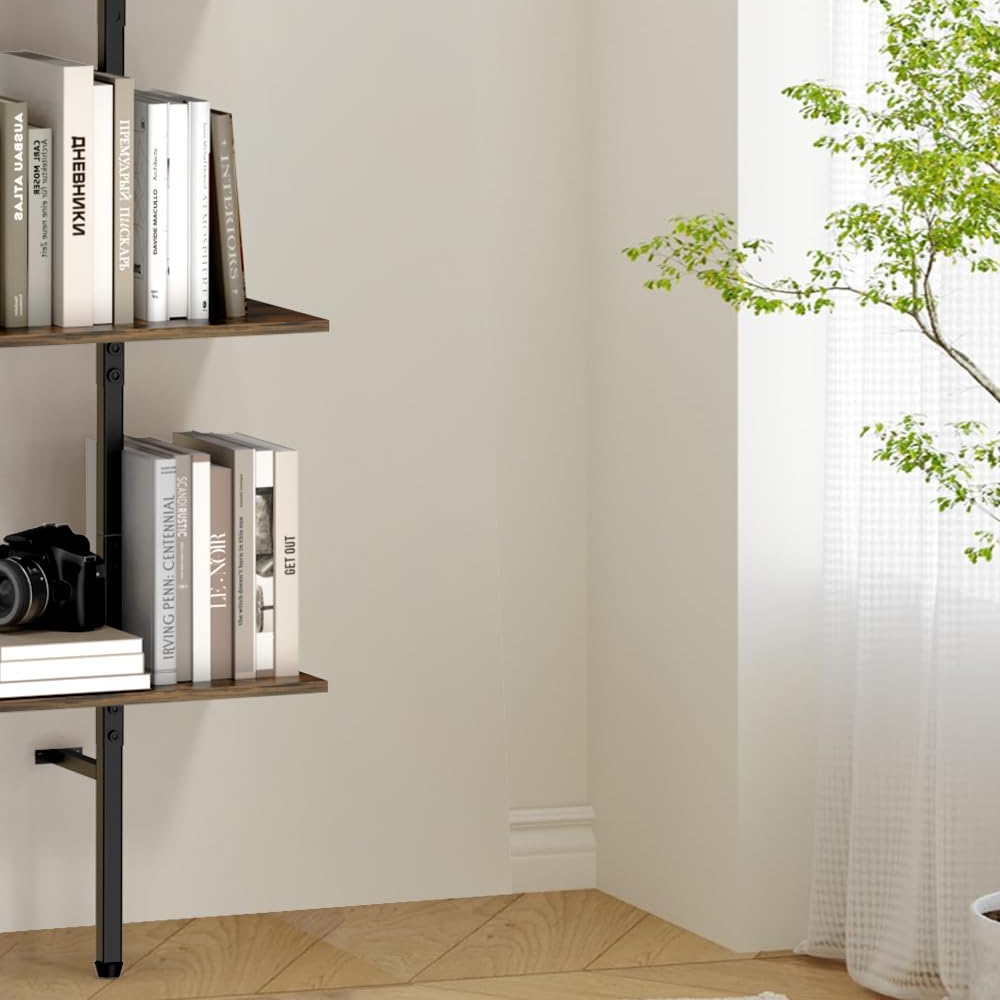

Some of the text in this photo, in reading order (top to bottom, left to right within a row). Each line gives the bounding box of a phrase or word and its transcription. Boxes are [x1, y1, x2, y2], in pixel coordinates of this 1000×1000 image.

[71, 136, 86, 236] ДНЕВНИКИ
[220, 155, 239, 280] INTERIORS
[163, 495, 175, 660] IRVING PENN: CENTENNIAL
[284, 536, 296, 575] GET OUT
